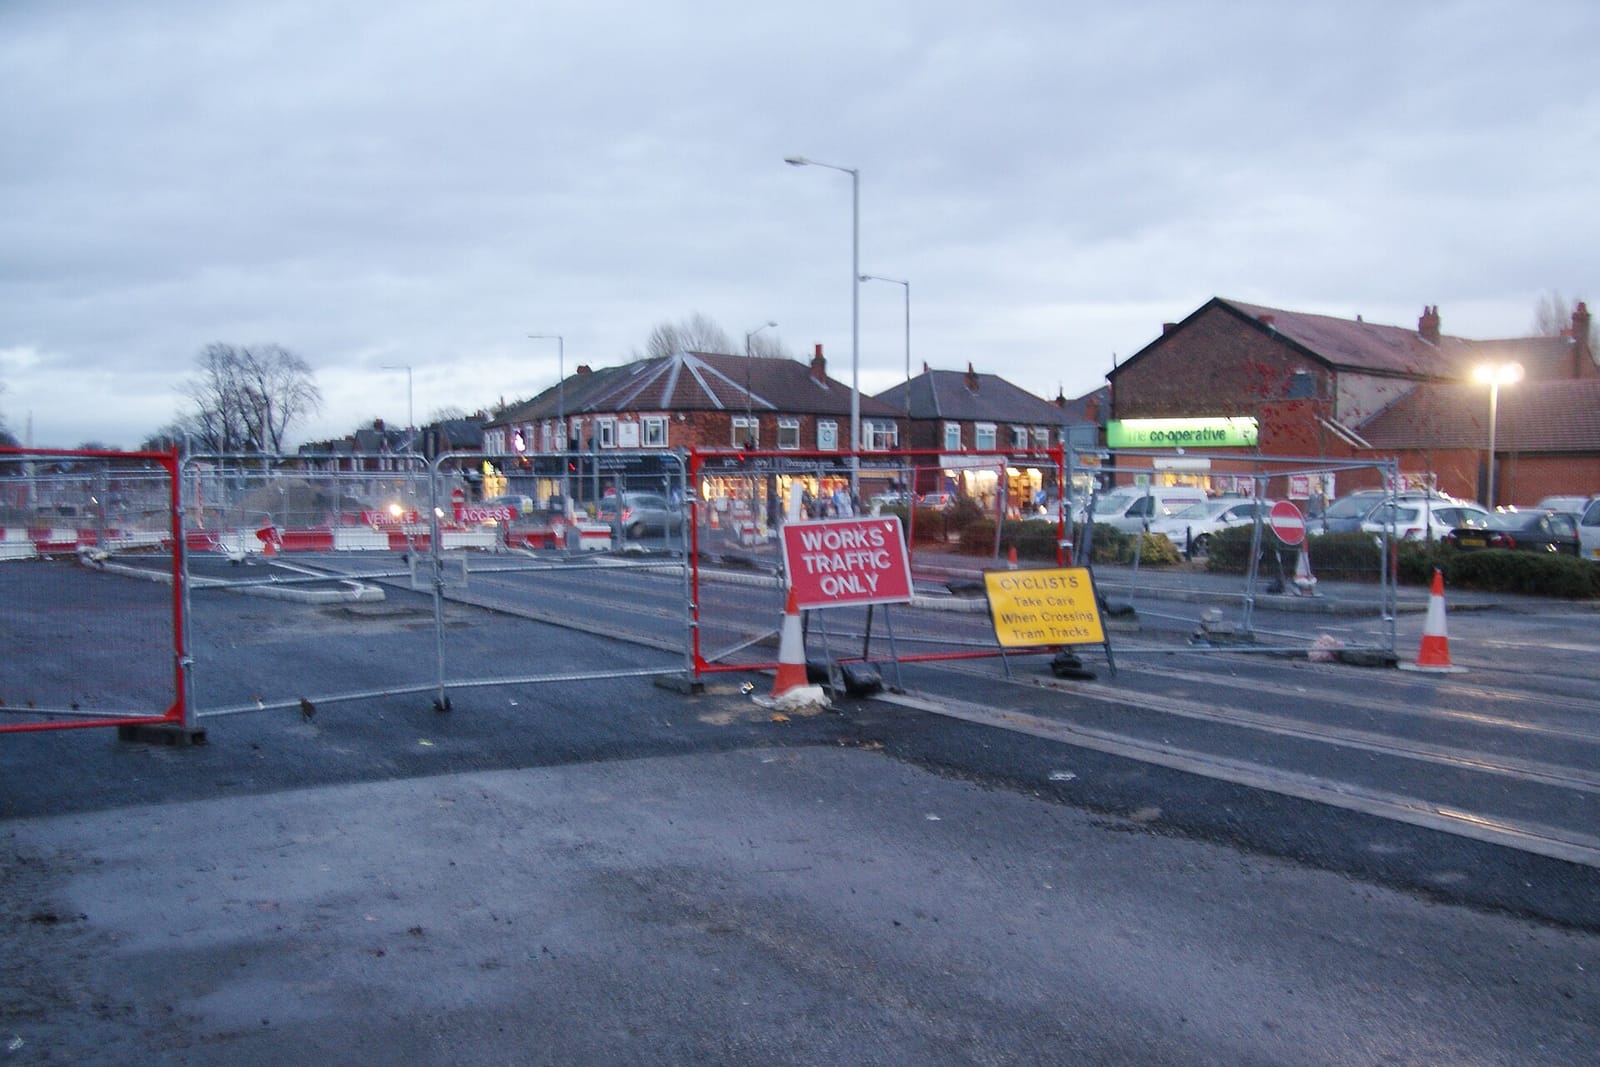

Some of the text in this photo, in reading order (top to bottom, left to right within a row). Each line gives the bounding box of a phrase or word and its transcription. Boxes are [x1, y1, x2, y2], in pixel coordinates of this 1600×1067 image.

[1150, 427, 1227, 444] co-operative
[365, 507, 511, 525] VEHICLE ACCESS
[800, 527, 885, 551] WORKS
[801, 549, 891, 574] TRAFFIC
[820, 572, 879, 597] ONLY
[1000, 576, 1079, 590] CYCLISTS
[1014, 596, 1075, 607] Take Care
[1001, 611, 1094, 624] When Crossing
[1013, 627, 1089, 639] Tram Tracks
